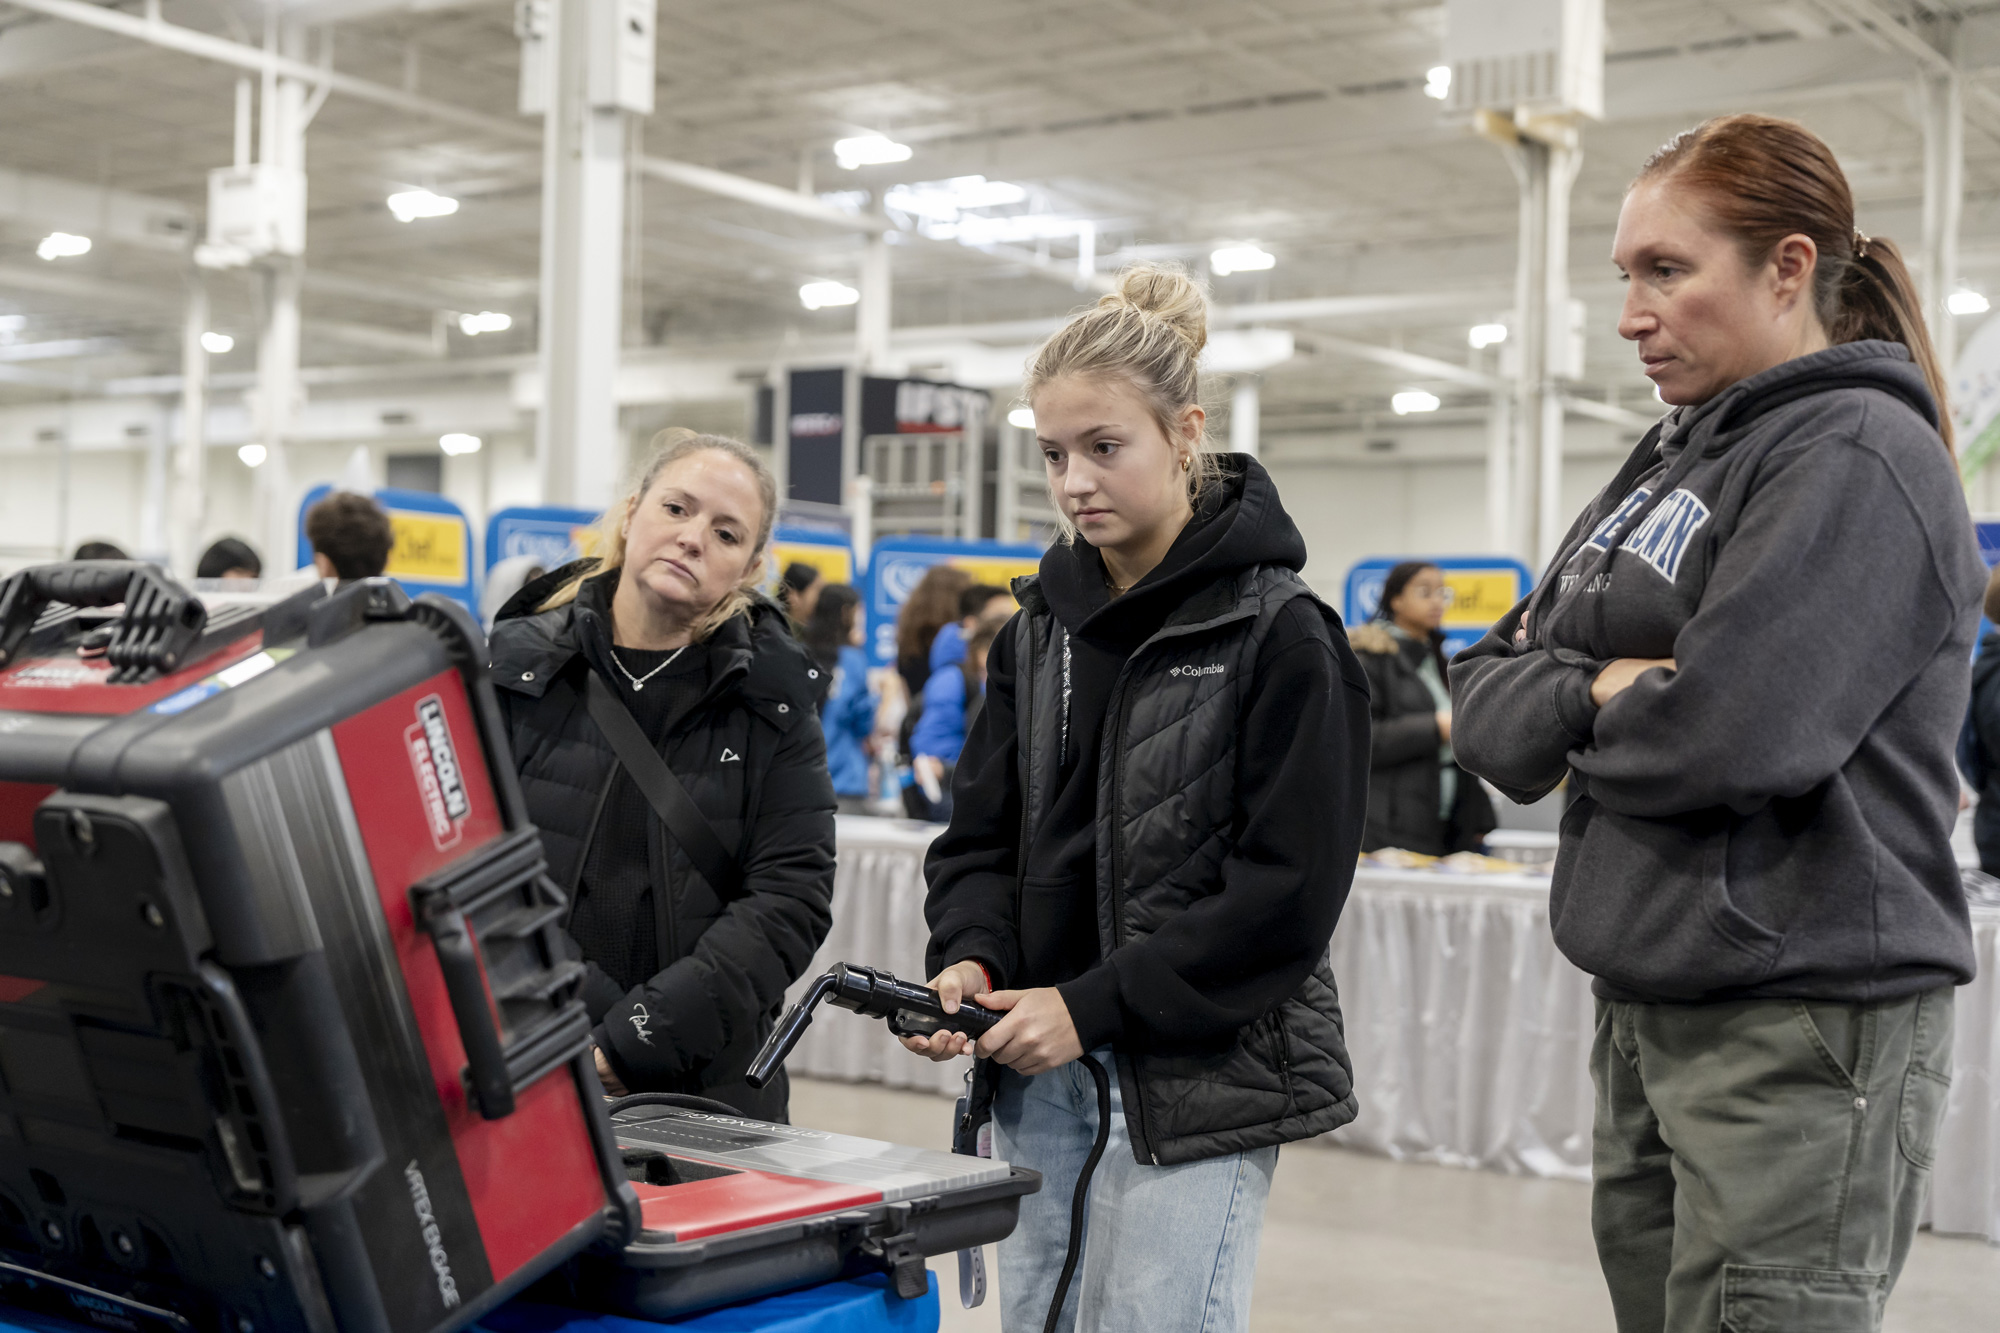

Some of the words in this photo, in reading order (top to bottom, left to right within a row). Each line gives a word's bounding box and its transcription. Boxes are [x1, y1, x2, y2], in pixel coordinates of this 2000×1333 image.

[1182, 663, 1225, 677] Columbia
[412, 736, 451, 837] ELECTRIC
[421, 701, 467, 817] LINCOLN
[404, 1158, 436, 1228] VRTEX
[422, 1223, 462, 1309] ENGAGE
